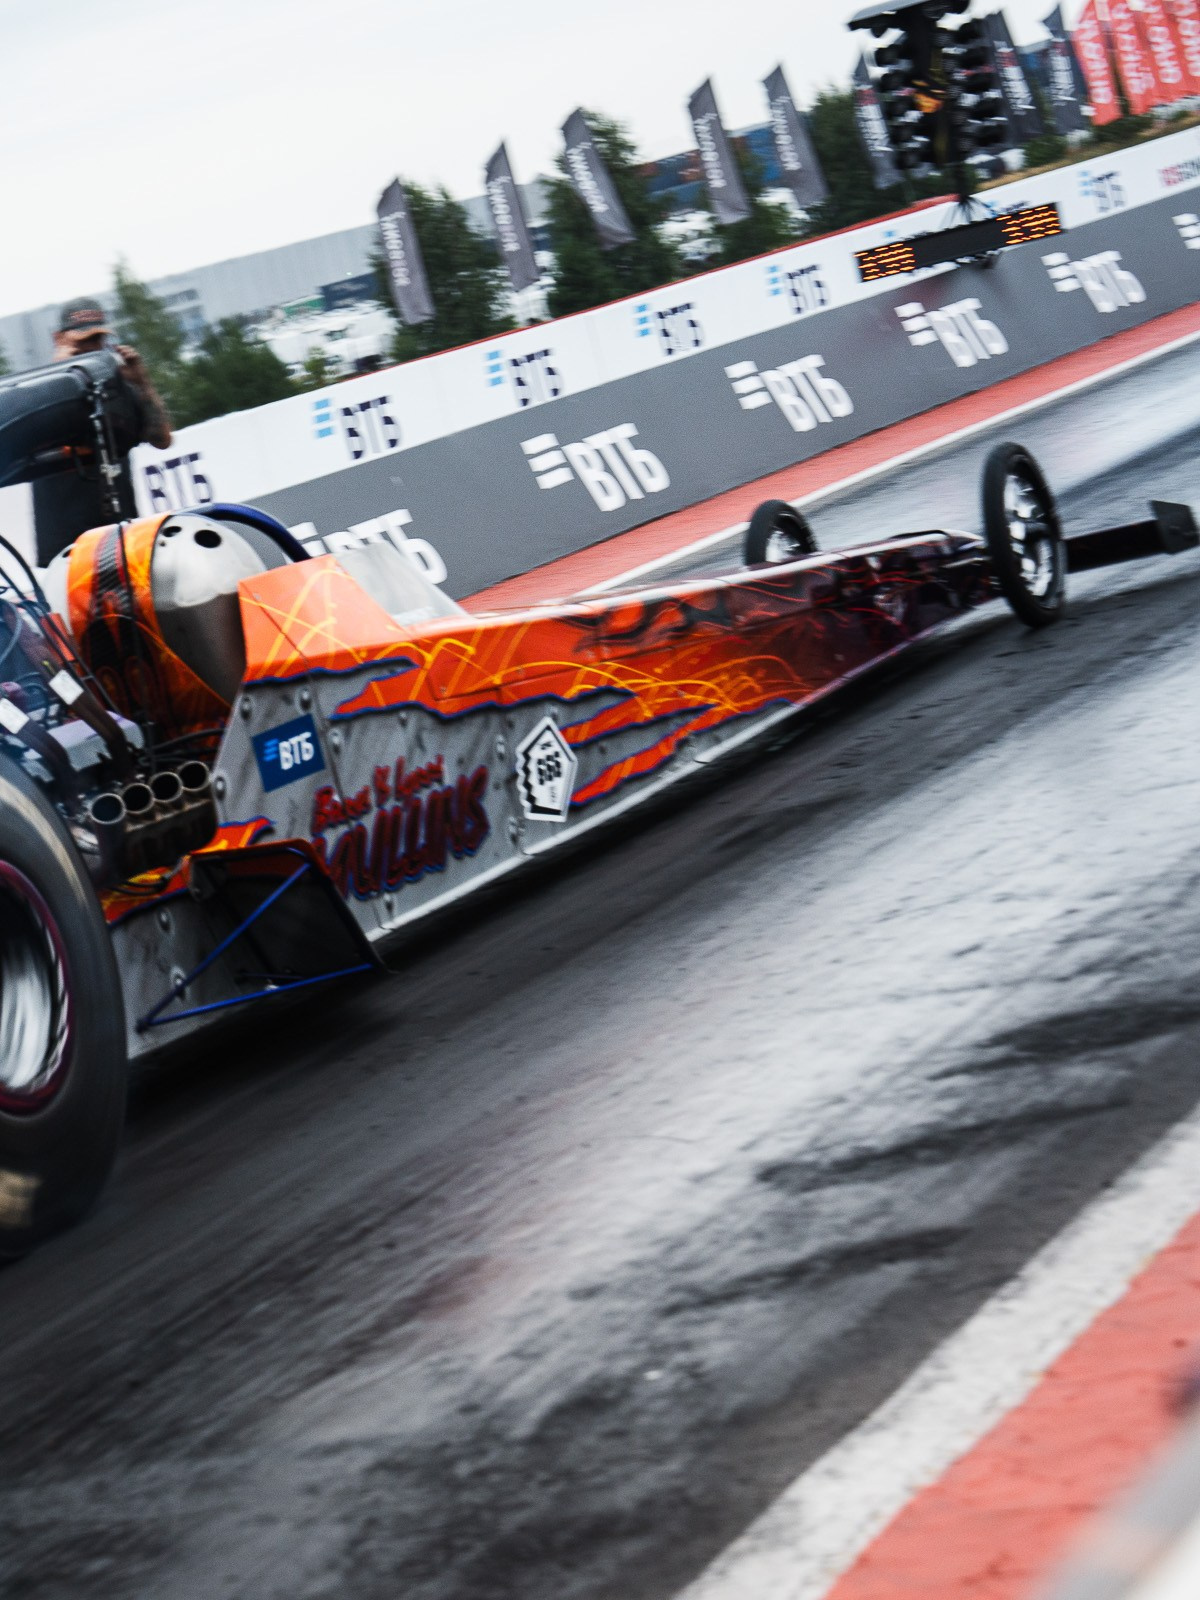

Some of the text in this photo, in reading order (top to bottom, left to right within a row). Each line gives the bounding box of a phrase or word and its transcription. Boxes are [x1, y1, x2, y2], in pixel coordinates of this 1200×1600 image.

[785, 264, 829, 314] ВТБ
[1070, 250, 1147, 314] ВТБ
[657, 303, 705, 356] ВТБ
[925, 298, 1009, 368] ВТБ
[510, 349, 564, 407] ВТБ
[760, 354, 855, 433] ВТБ
[340, 396, 402, 461] ВТБ
[145, 452, 213, 515] ВТБ
[562, 422, 670, 512] ВТБ
[278, 731, 315, 770] ВТБ
